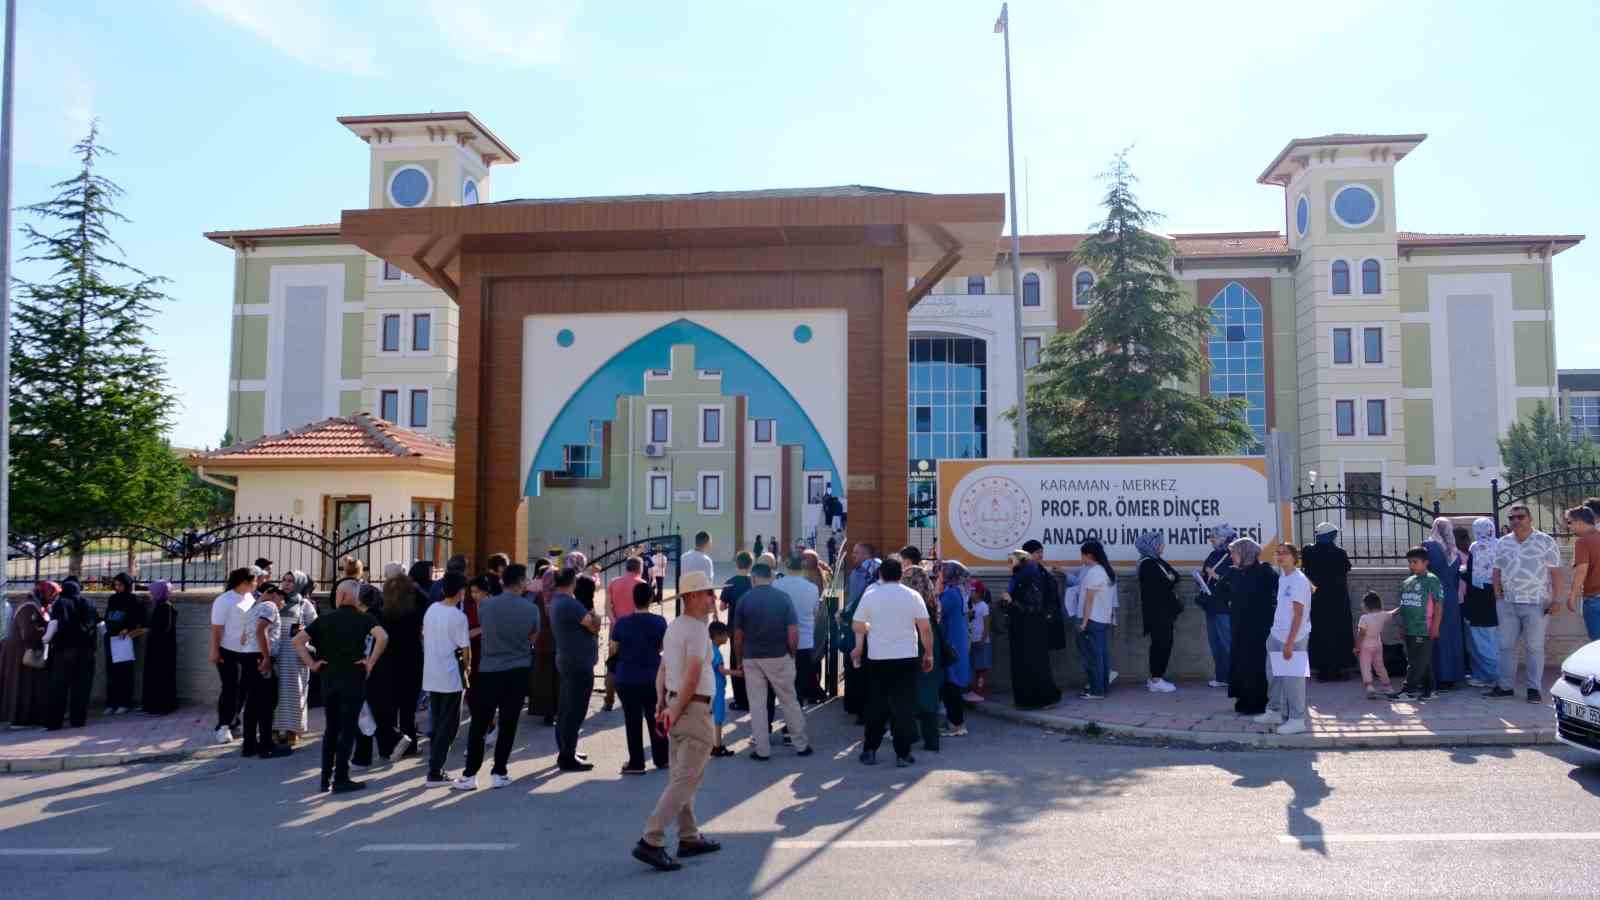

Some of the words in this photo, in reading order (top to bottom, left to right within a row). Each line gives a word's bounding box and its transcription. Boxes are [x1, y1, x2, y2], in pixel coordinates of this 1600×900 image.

[1040, 479, 1110, 491] KARAMAN
[1122, 479, 1177, 491] MERKEZ
[1041, 499, 1083, 517] PROF.
[1087, 499, 1112, 517] DR.
[1115, 495, 1160, 517] ÖMER
[1163, 495, 1220, 521] DİNÇER
[1042, 527, 1117, 545] ANADOLU
[1121, 523, 1164, 545] İM
